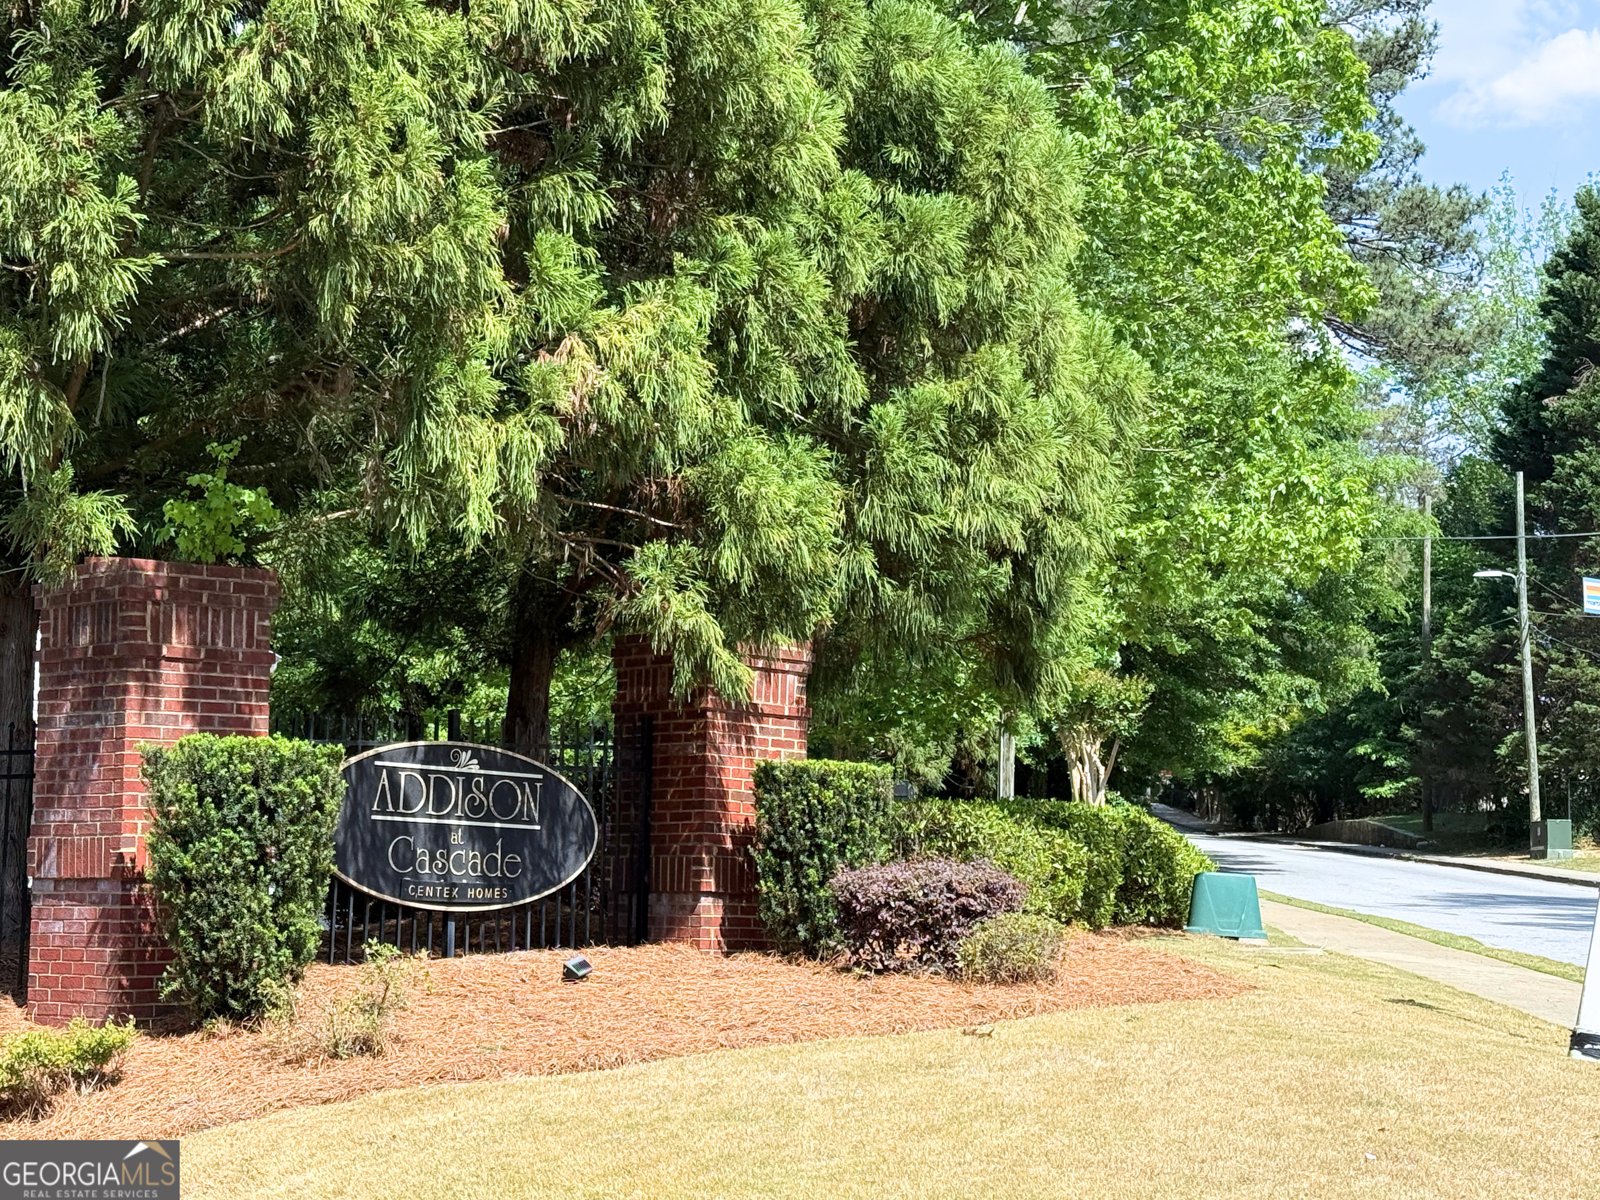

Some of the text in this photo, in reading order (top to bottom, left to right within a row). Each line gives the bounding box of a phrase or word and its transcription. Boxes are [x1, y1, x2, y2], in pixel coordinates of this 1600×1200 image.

[371, 768, 543, 824] ADDISON
[450, 828, 465, 845] at
[387, 835, 522, 878] Cascade
[408, 884, 508, 899] CENTEX HOMES
